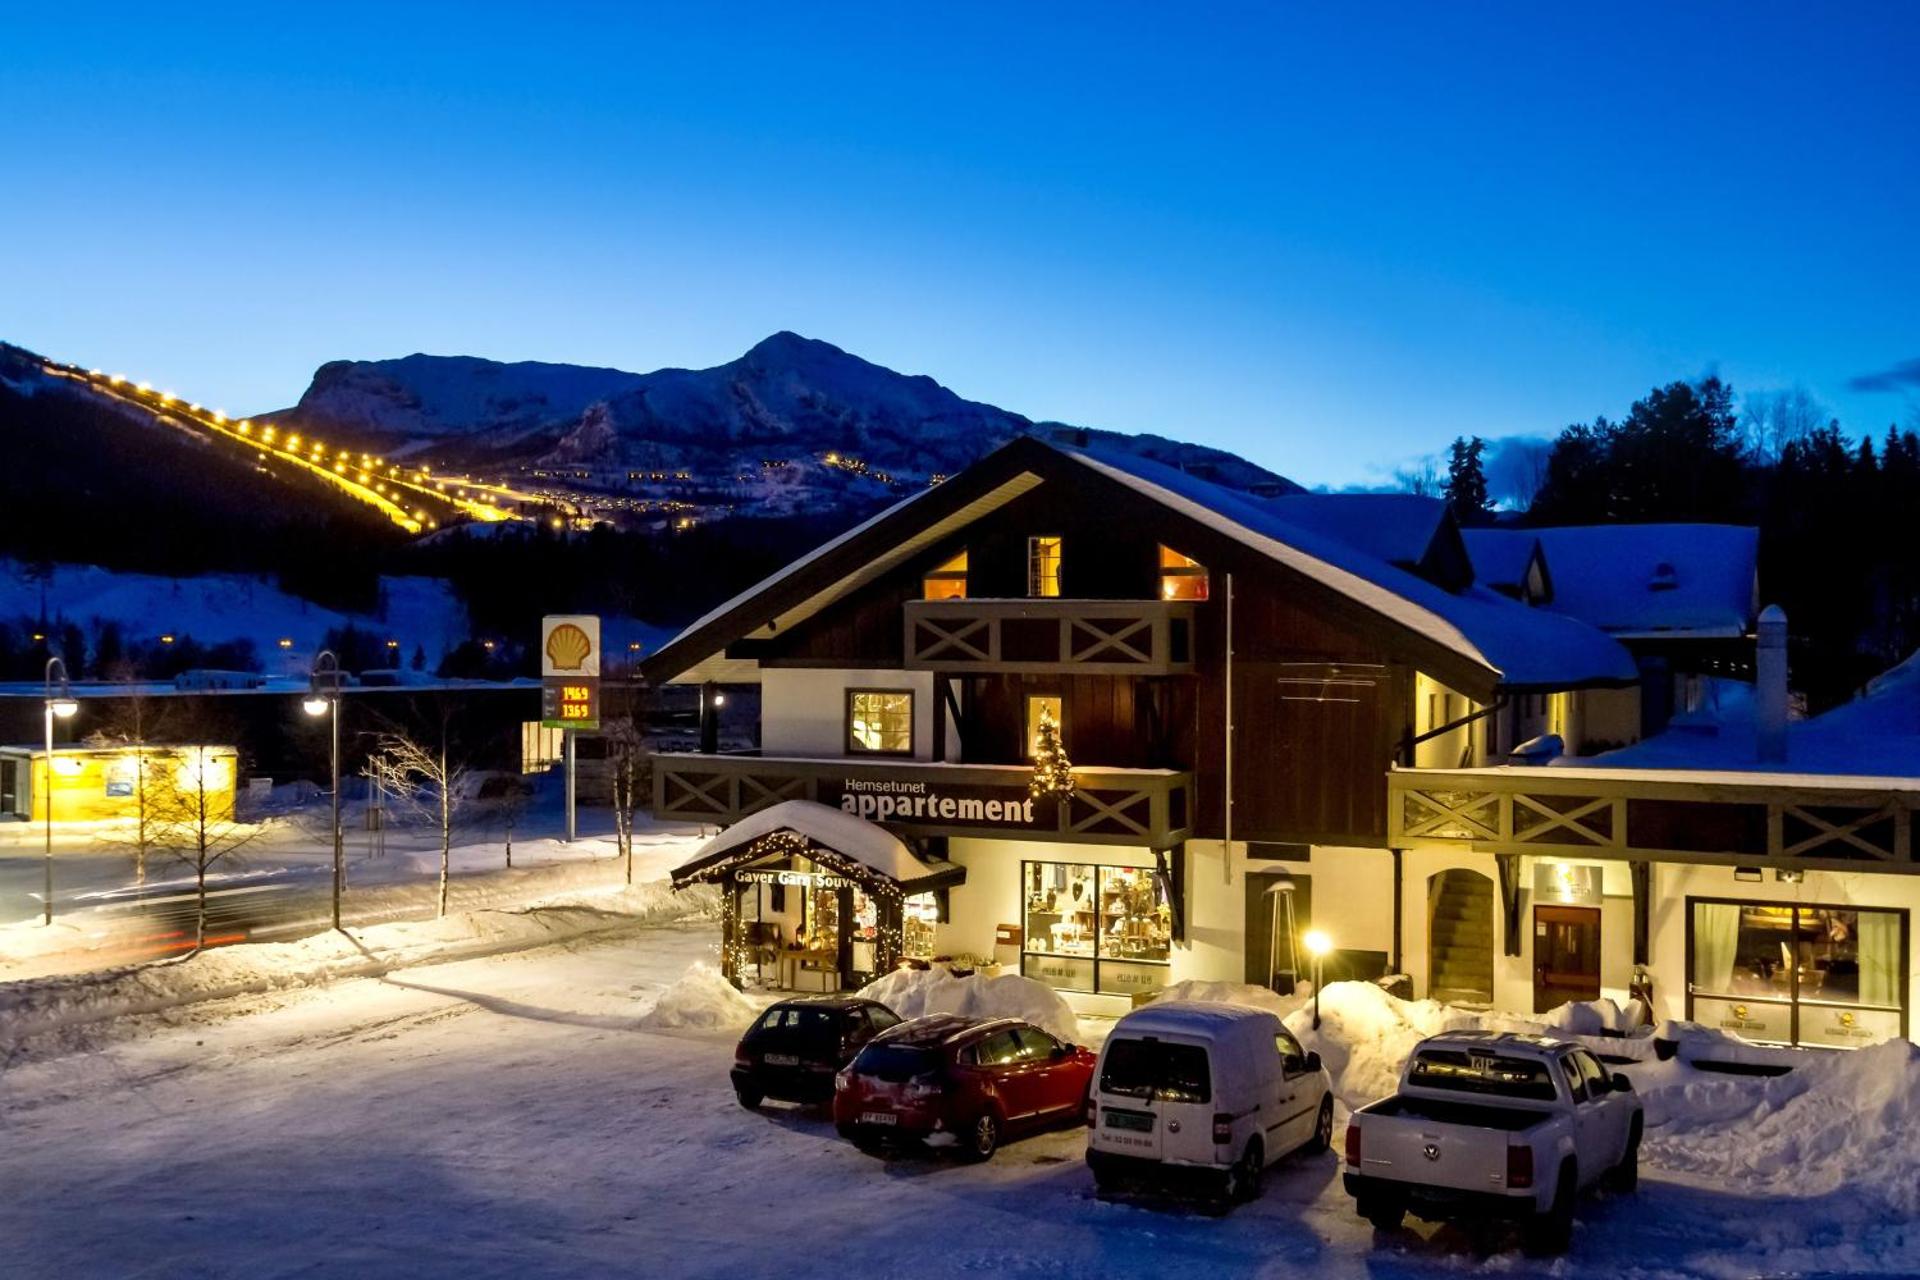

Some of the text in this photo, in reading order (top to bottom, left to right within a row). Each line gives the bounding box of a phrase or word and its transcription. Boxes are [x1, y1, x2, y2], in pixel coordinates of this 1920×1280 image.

[562, 705, 588, 718] 1369
[845, 778, 925, 794] Hemsetunet
[841, 793, 1034, 823] appartement
[734, 870, 774, 884] Gaver
